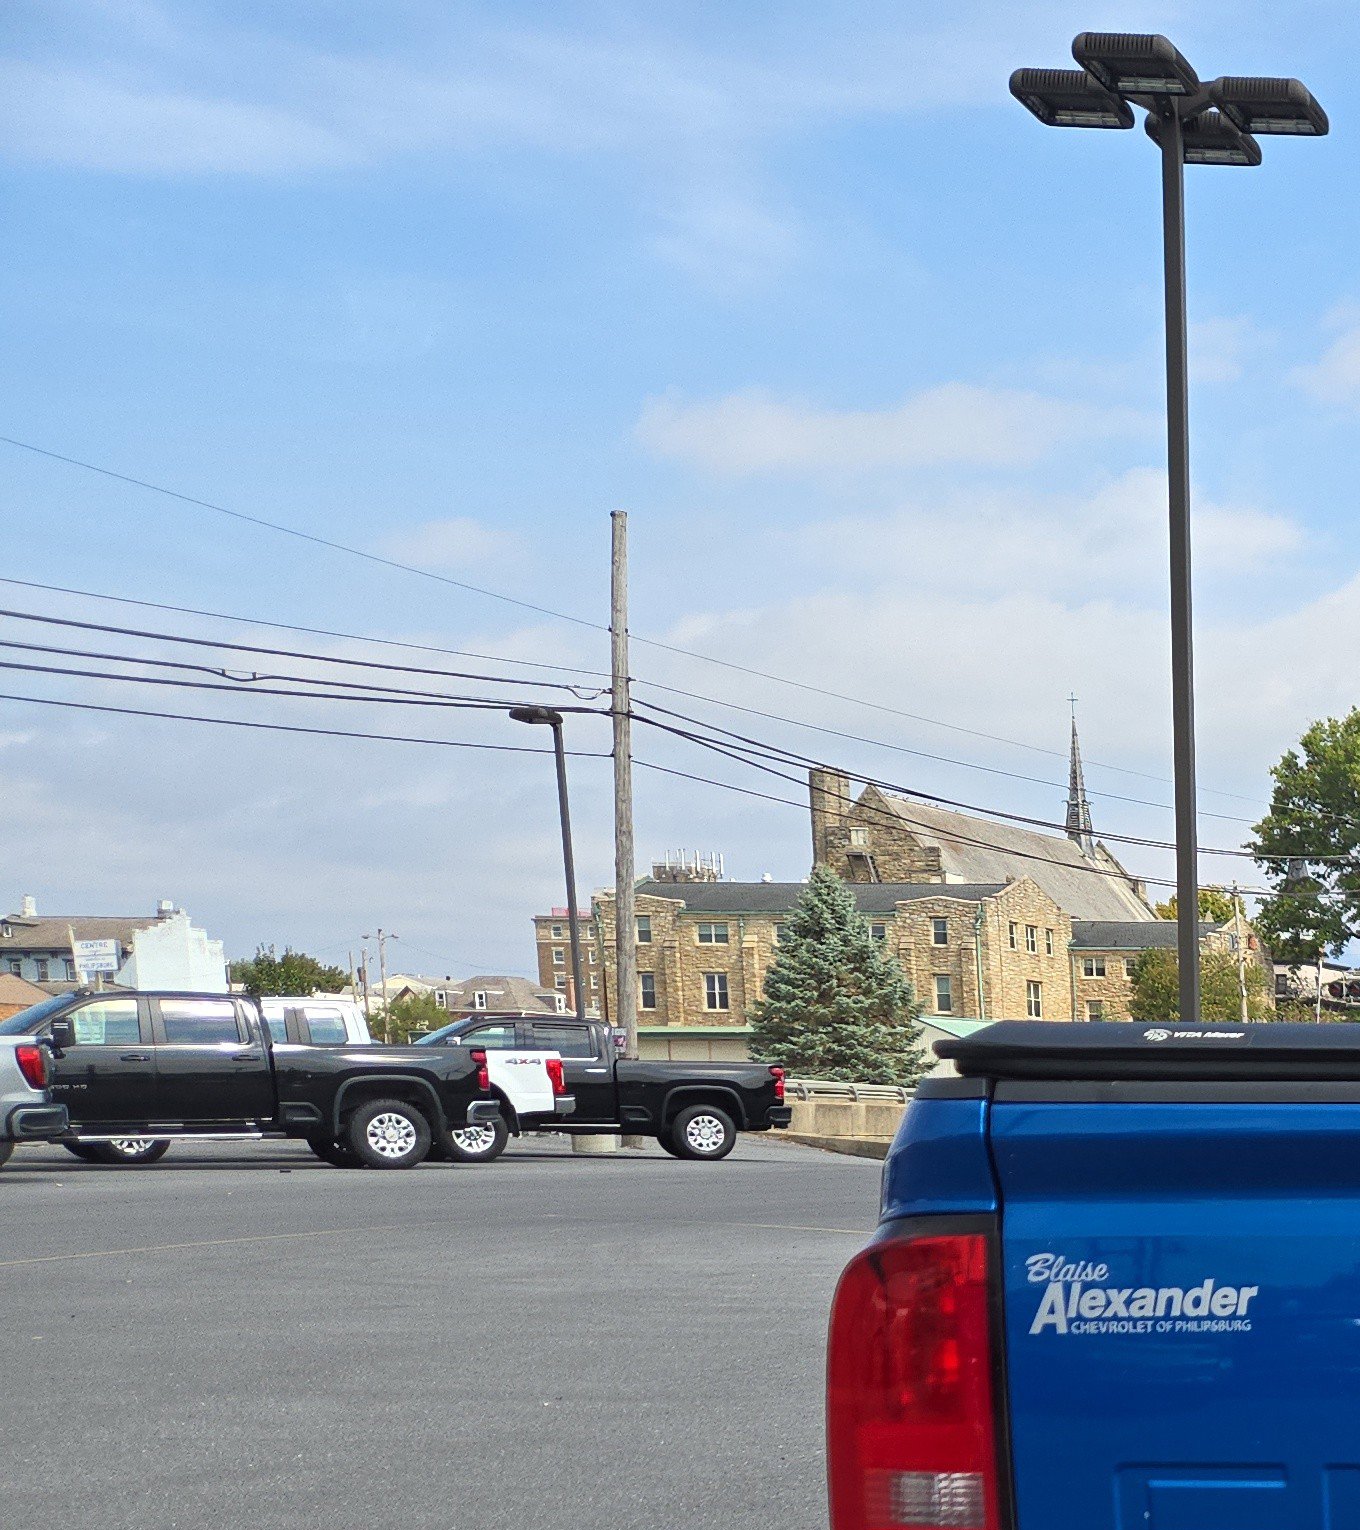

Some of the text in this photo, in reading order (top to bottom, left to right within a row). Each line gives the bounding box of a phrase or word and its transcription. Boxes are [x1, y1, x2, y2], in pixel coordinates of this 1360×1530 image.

[1025, 1252, 1109, 1283] Blaise
[1028, 1278, 1259, 1335] Alexander
[1070, 1319, 1252, 1335] CHEVROLET OF PHILIPSBURG
